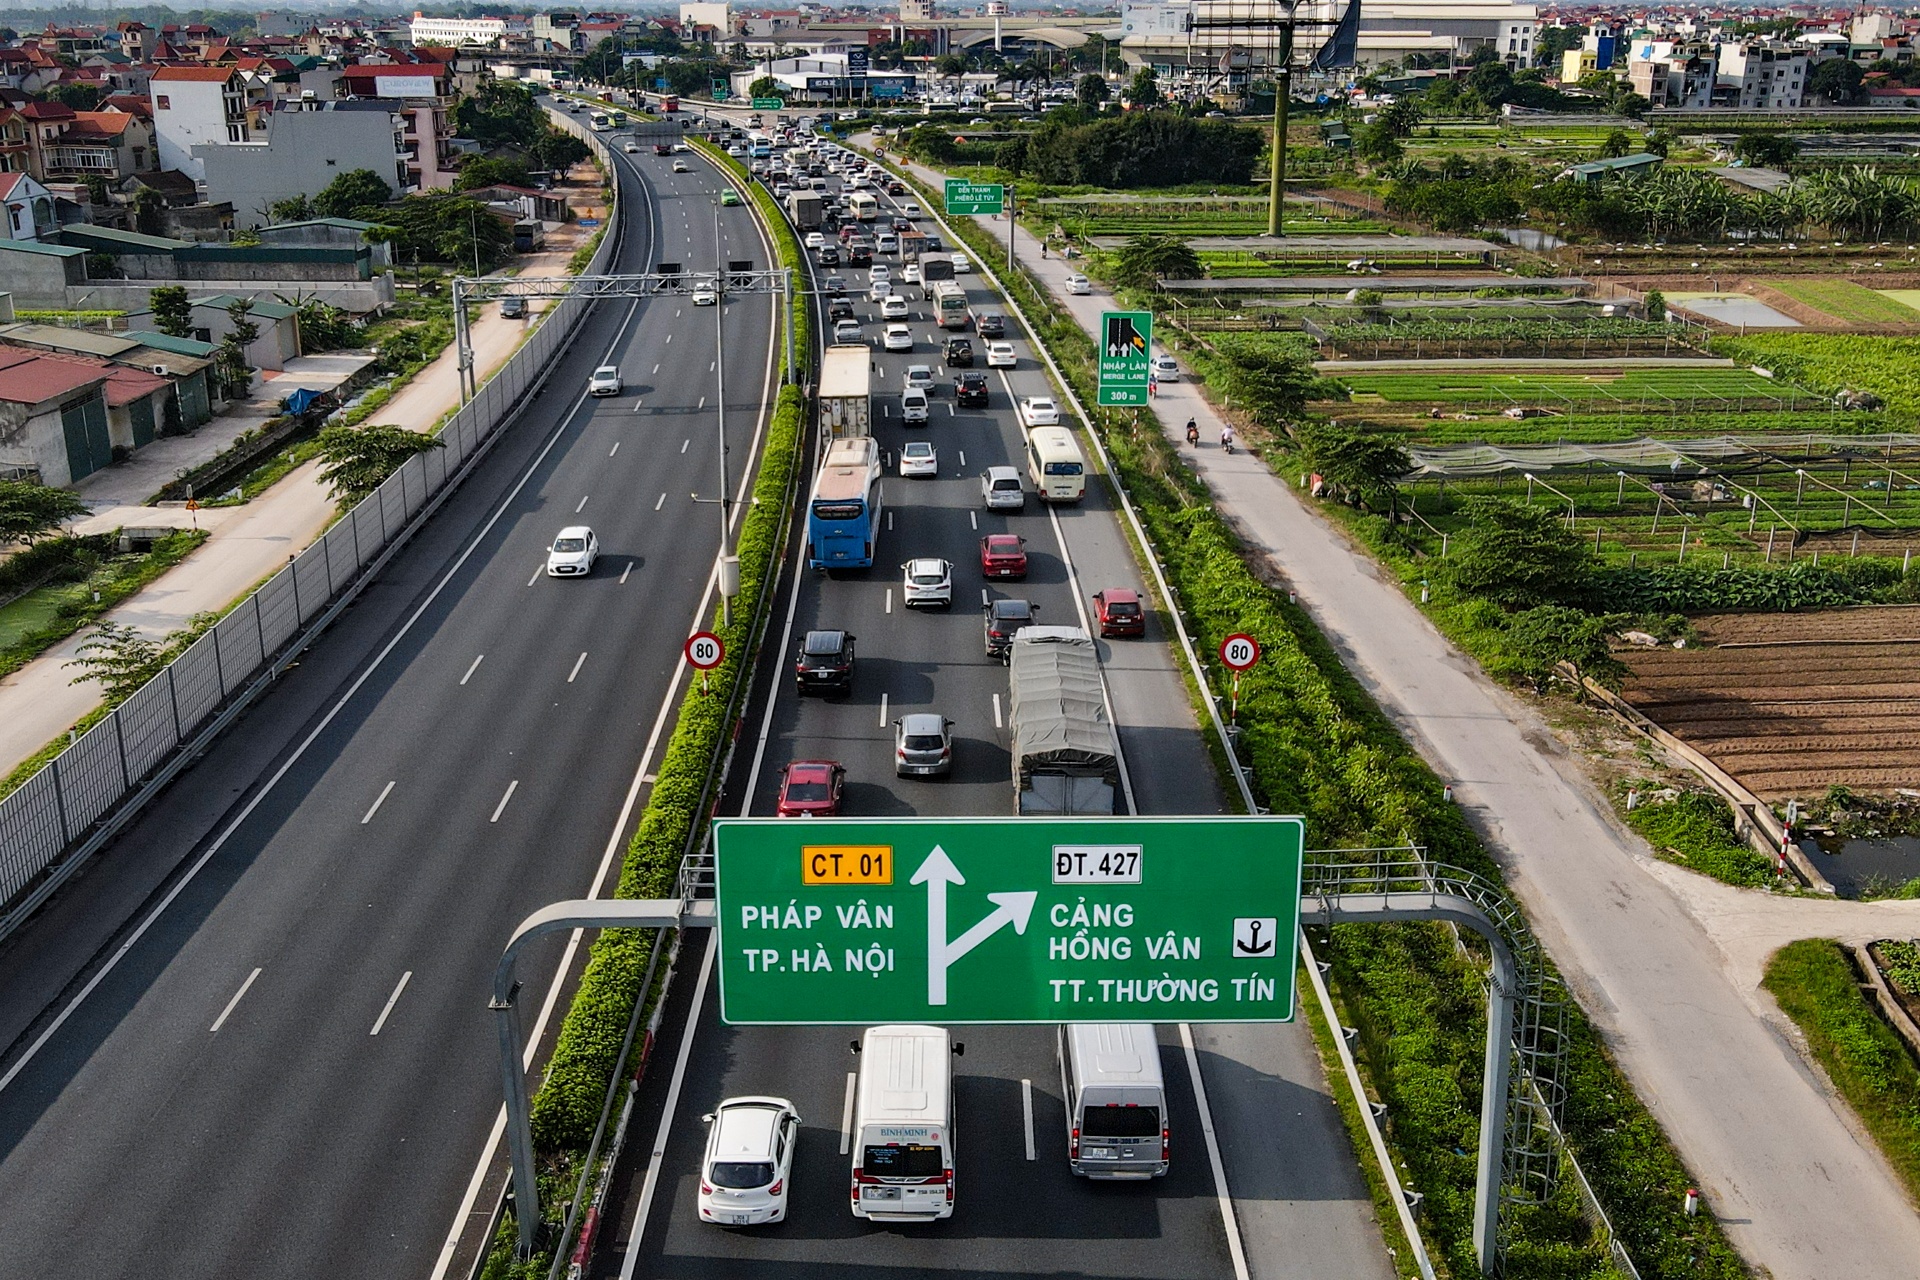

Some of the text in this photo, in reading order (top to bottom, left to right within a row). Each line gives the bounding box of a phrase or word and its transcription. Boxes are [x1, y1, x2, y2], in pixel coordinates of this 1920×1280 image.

[1103, 360, 1147, 372] NHẬP LÀN
[1110, 391, 1128, 401] 300
[696, 643, 713, 658] 80
[1231, 644, 1248, 660] 80
[812, 853, 883, 878] CT.01
[1056, 852, 1138, 876] ĐT.427
[742, 898, 894, 929] PHÁP VÂN
[1050, 896, 1133, 928] CẢNG
[1049, 928, 1201, 960] HỒNG VÂN
[742, 942, 894, 978] TP.HÀ NỘI
[1049, 970, 1275, 1003] TT.THƯỜNG TÍN
[880, 1128, 927, 1136] BÌNH MINH
